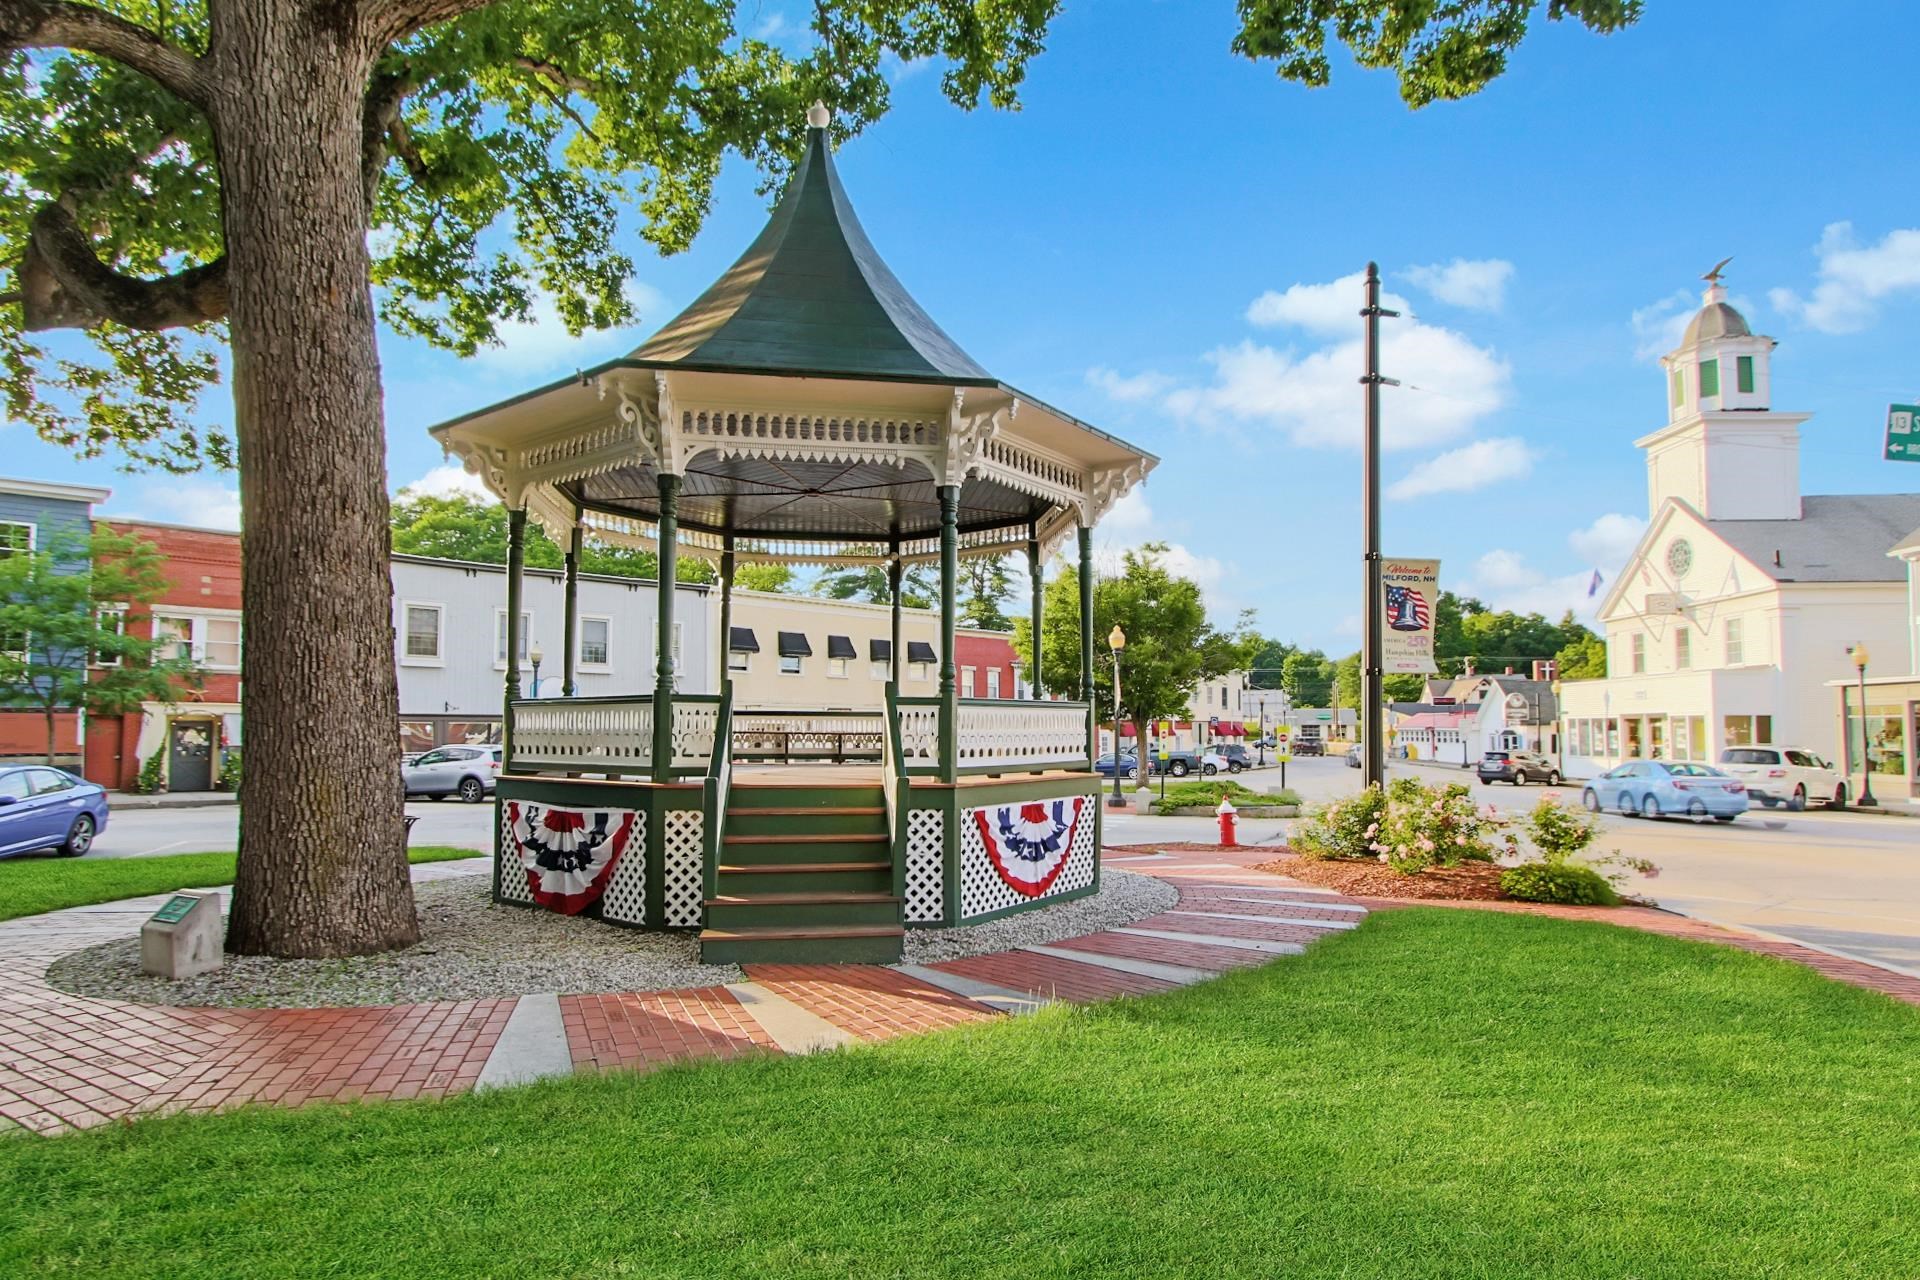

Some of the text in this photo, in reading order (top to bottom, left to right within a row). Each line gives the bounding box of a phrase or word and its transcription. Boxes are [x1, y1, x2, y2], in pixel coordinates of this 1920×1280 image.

[1895, 416, 1907, 429] 13
[1387, 563, 1432, 575] Welcome to
[1382, 574, 1421, 583] MILFORD,
